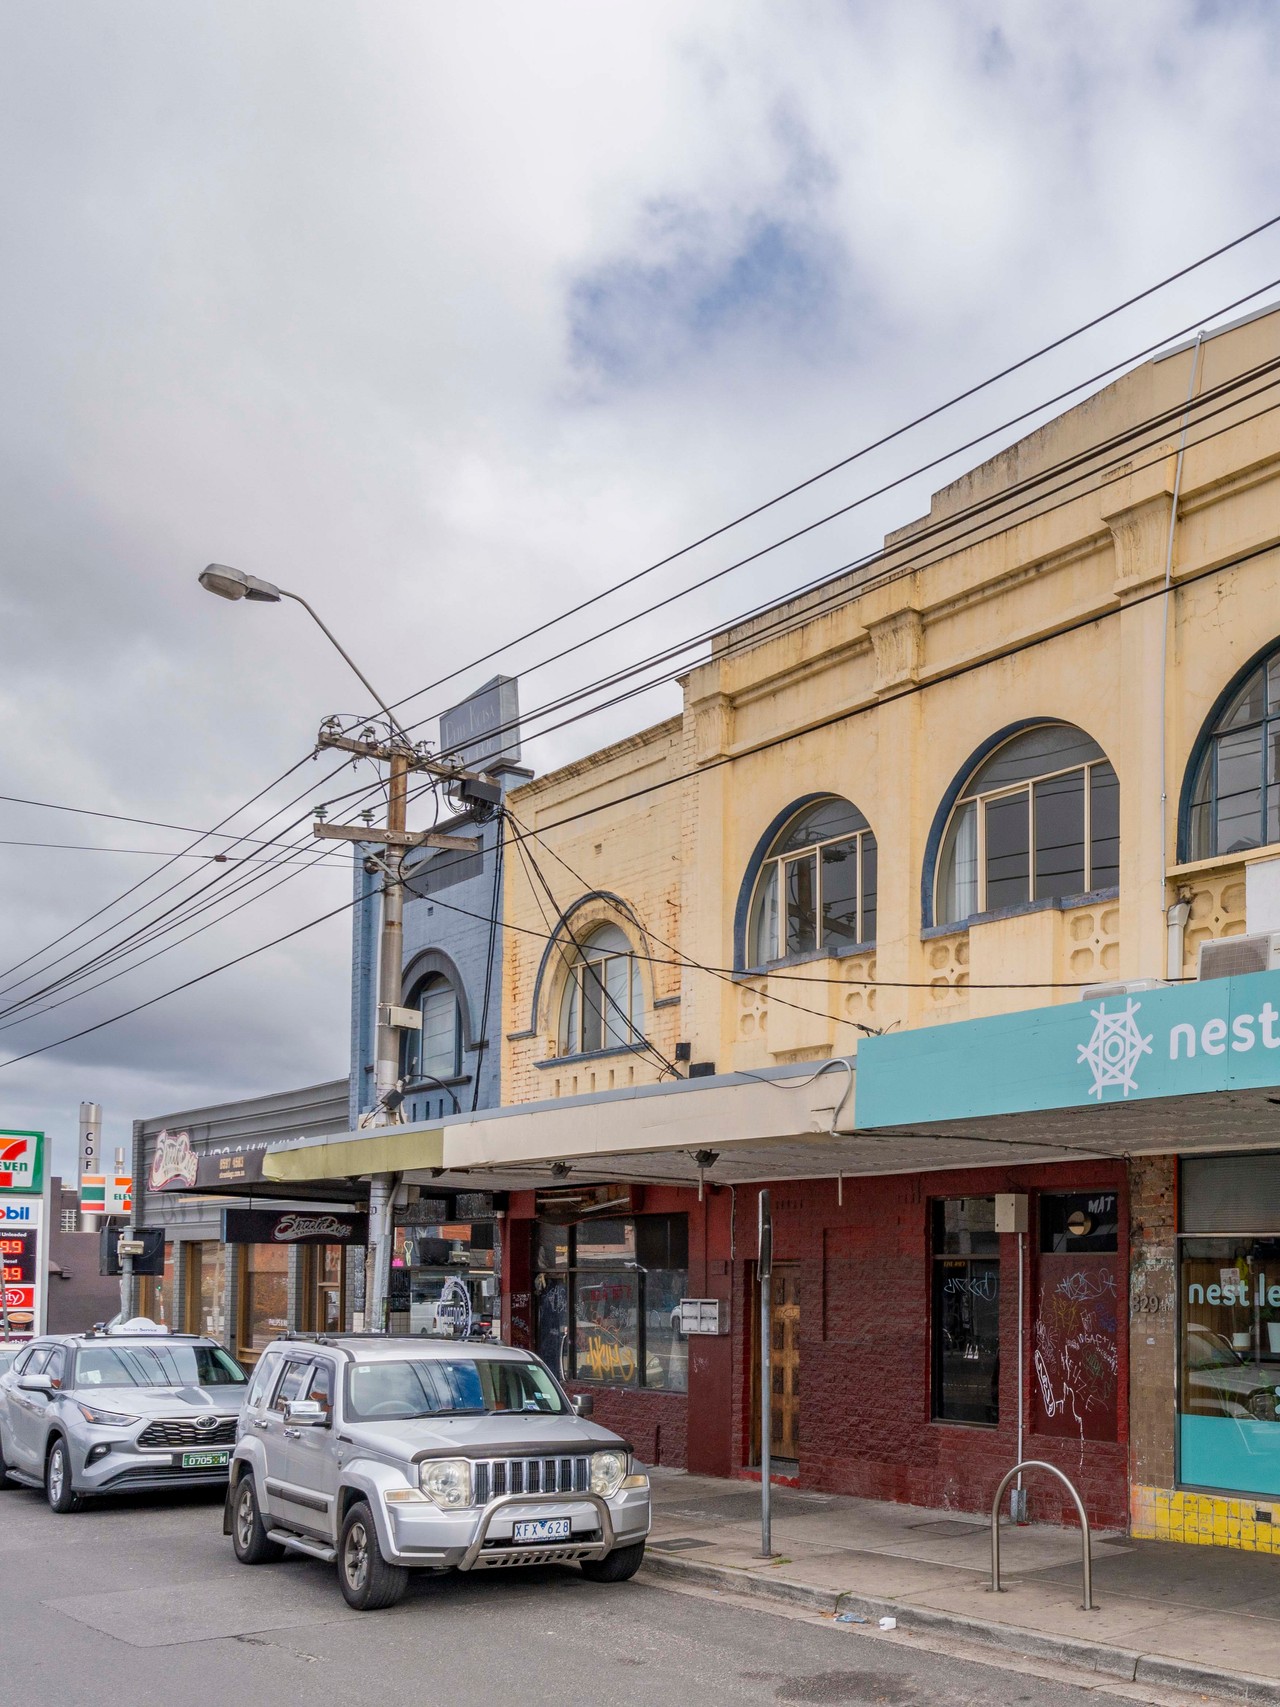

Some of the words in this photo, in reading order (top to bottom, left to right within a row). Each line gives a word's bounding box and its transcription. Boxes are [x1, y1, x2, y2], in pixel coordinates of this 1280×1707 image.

[0, 1162, 28, 1171] VEn
[273, 1214, 319, 1241] Street
[316, 1216, 352, 1237] Dogz
[1188, 1280, 1250, 1306] nest
[1131, 1295, 1160, 1313] 829
[189, 1456, 212, 1465] 0705
[516, 1523, 538, 1537] XFX
[547, 1521, 569, 1534] 628
